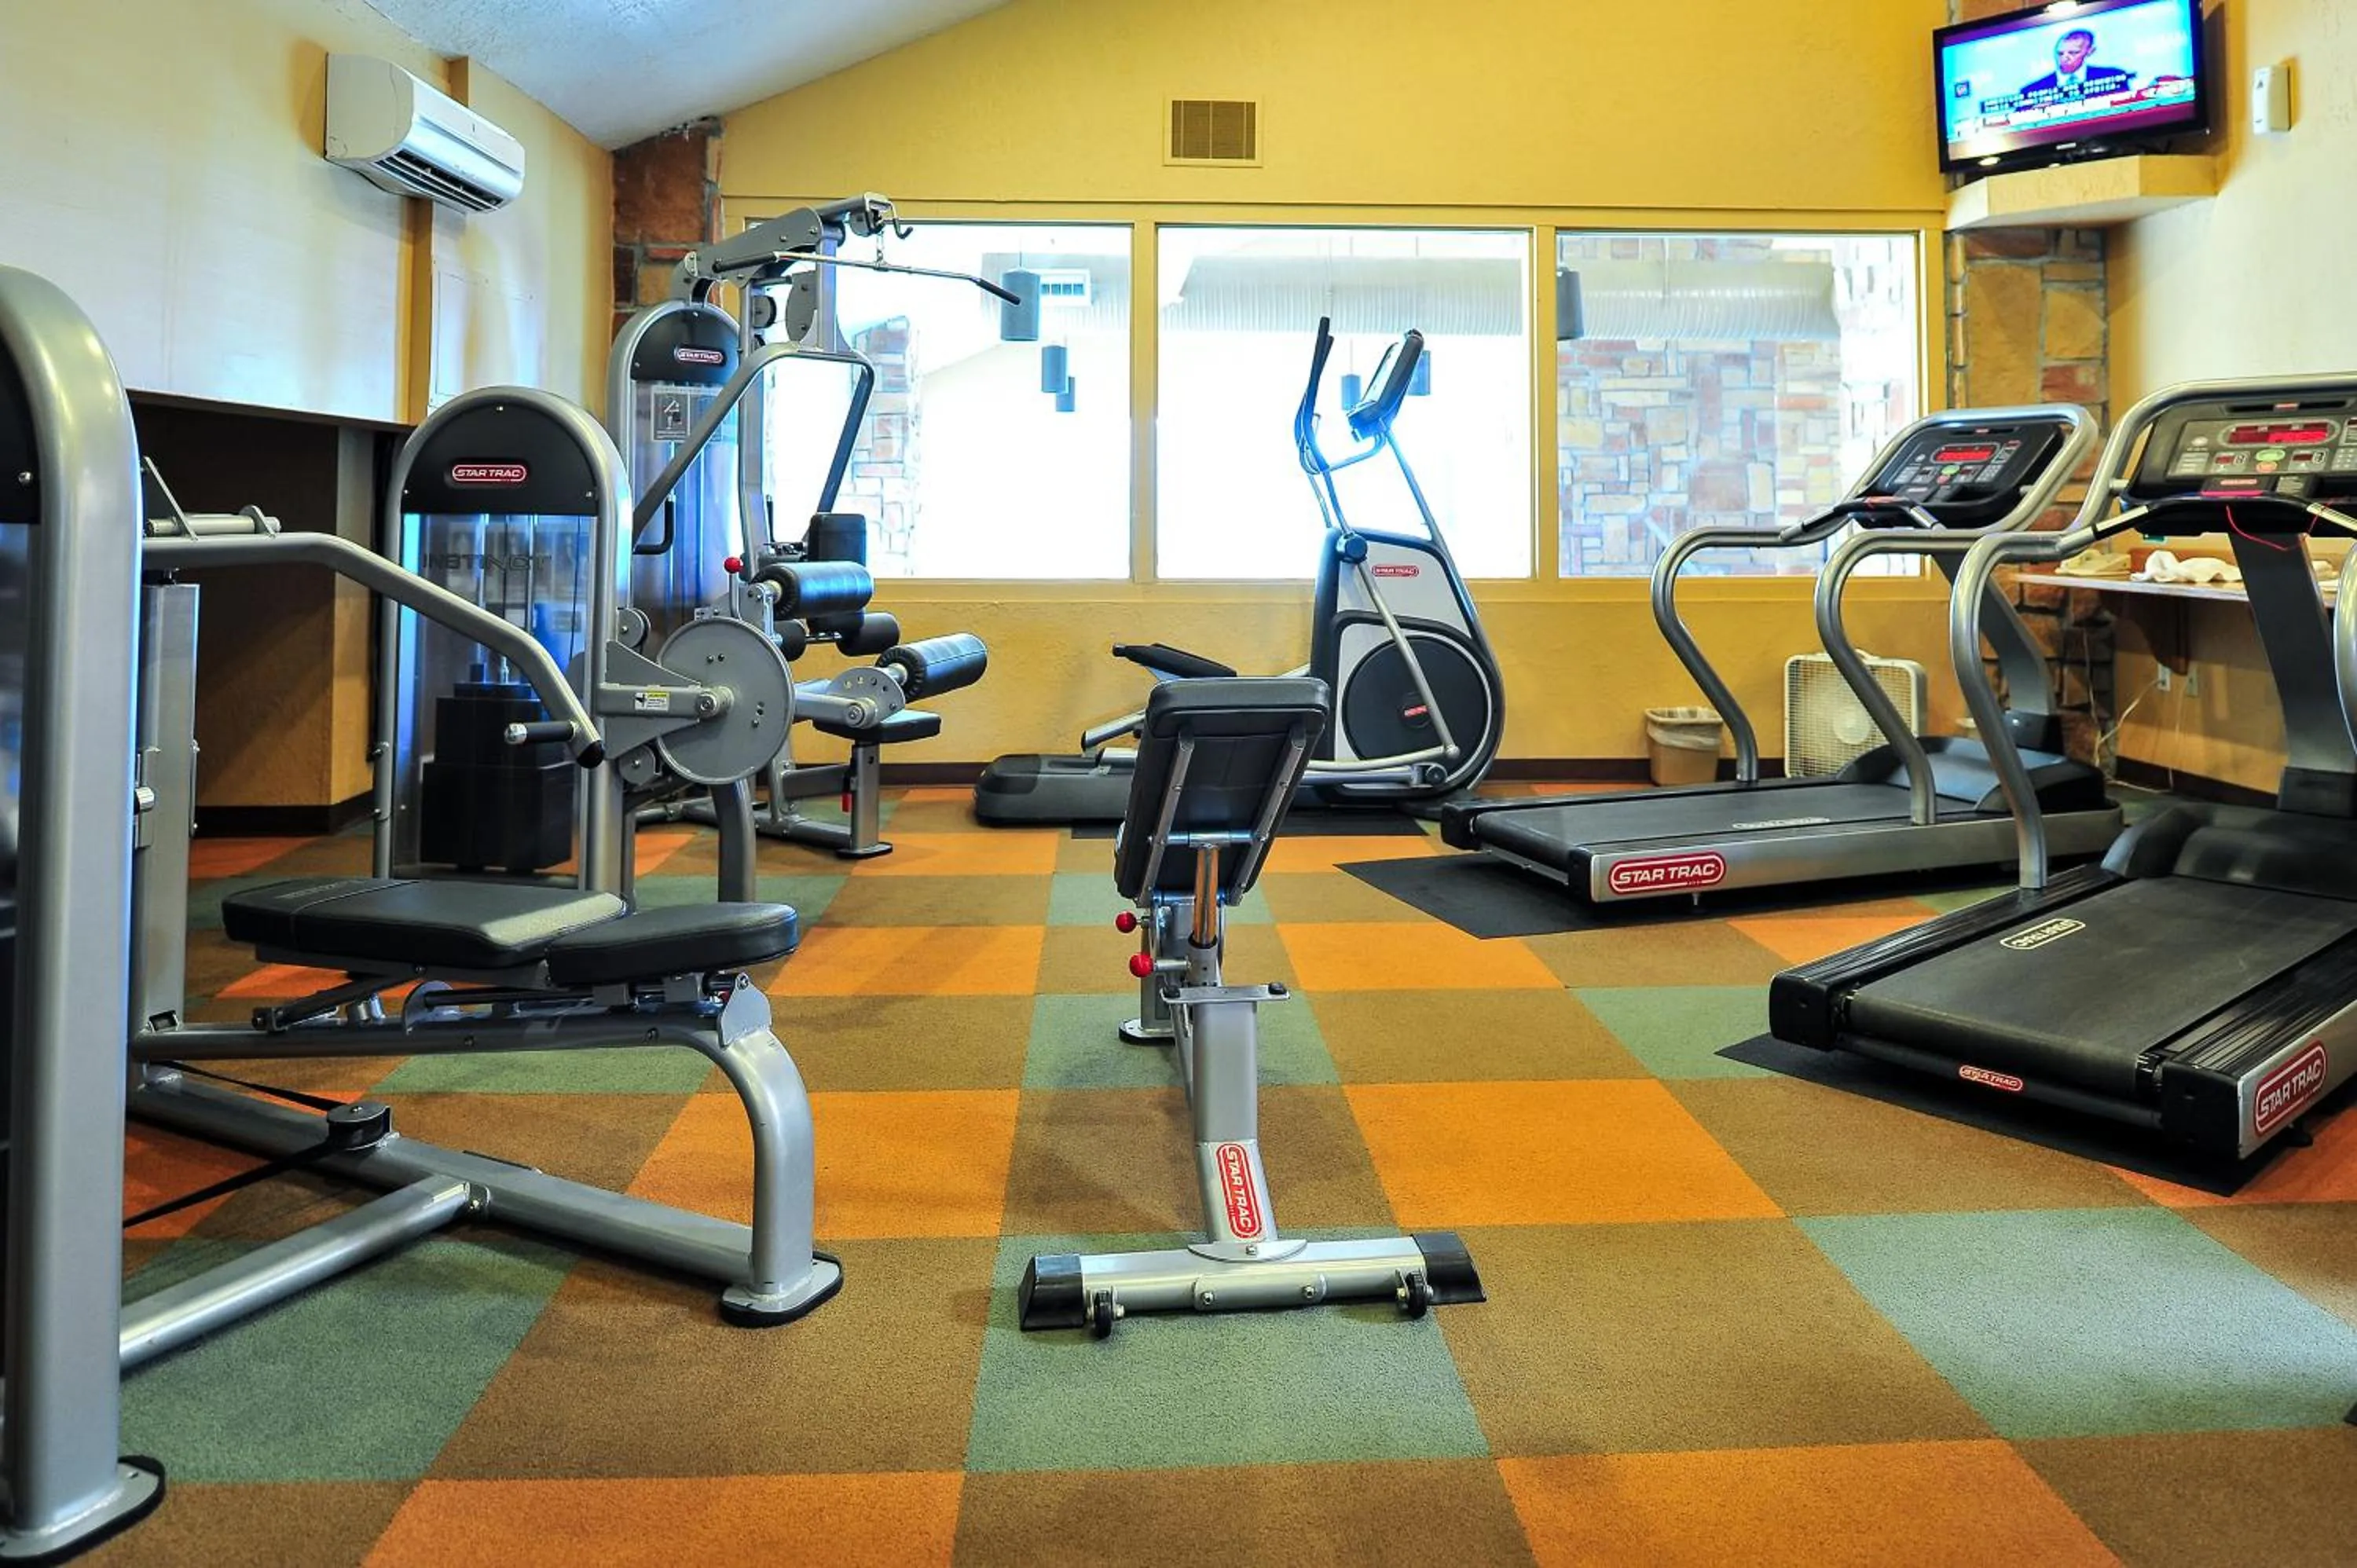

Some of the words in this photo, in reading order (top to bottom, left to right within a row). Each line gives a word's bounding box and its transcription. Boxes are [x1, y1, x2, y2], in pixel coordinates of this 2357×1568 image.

[456, 469, 487, 478] STAR
[1615, 866, 1666, 885] STAR
[1667, 863, 1717, 880] TRAC
[1963, 1068, 1989, 1081] STAR
[1989, 1073, 2018, 1087] TRAC
[2259, 1083, 2290, 1117] STAR
[2292, 1059, 2323, 1095] TRAC
[1226, 1146, 1243, 1185] STAR
[1233, 1187, 1252, 1229] TRAC
